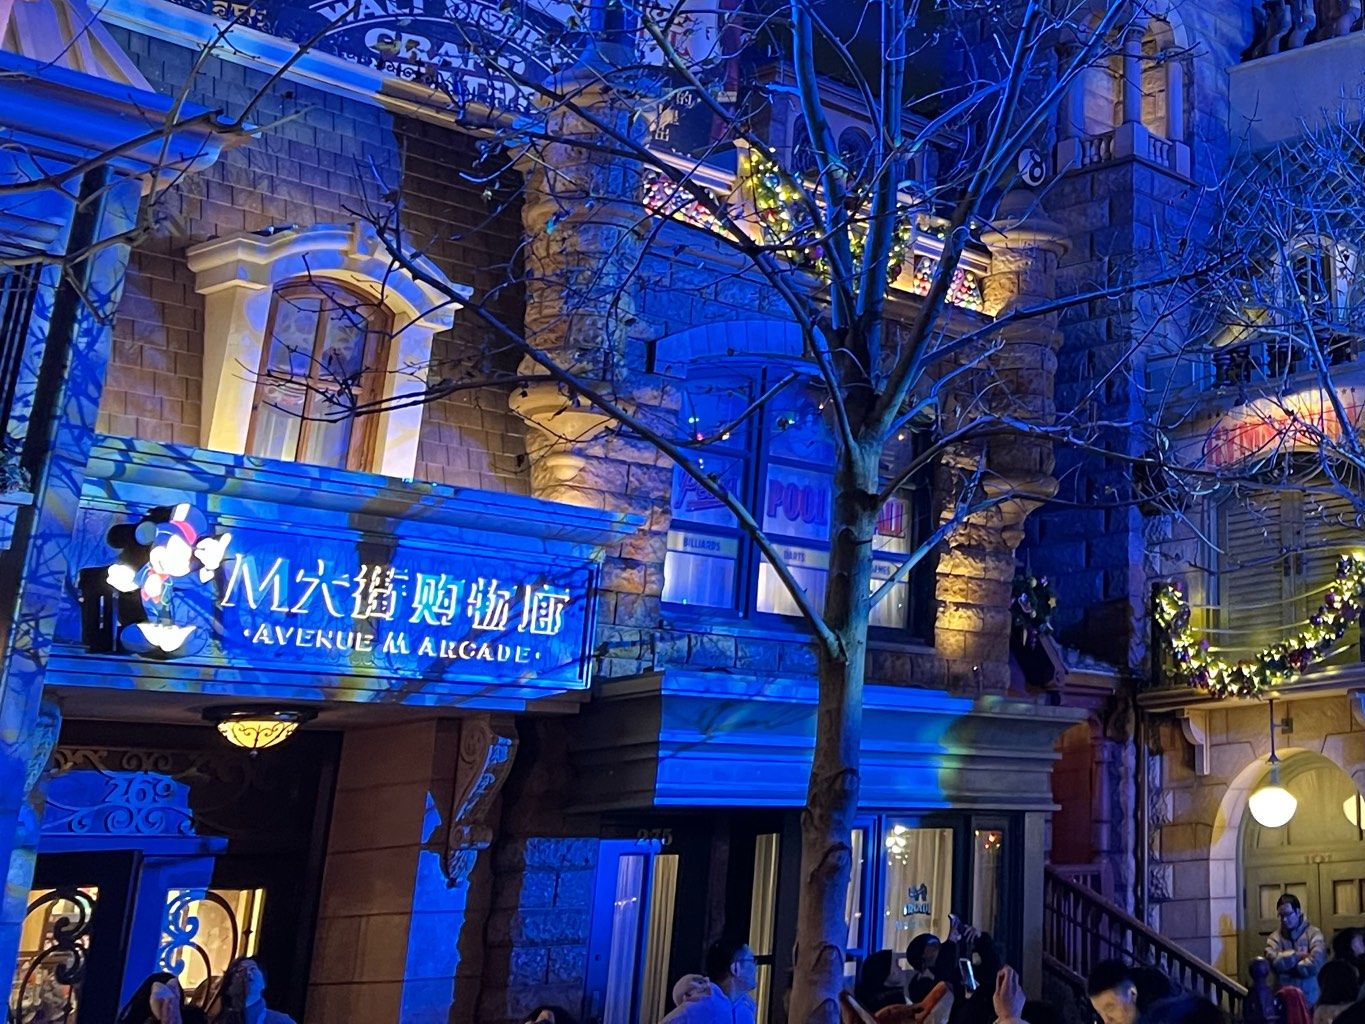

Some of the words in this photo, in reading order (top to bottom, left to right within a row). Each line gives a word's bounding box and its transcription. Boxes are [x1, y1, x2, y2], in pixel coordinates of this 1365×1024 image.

[364, 28, 527, 76] GRAD
[252, 623, 375, 652] AVENUE
[383, 631, 411, 655] M
[418, 636, 532, 664] ARCADE
[104, 776, 175, 806] 269
